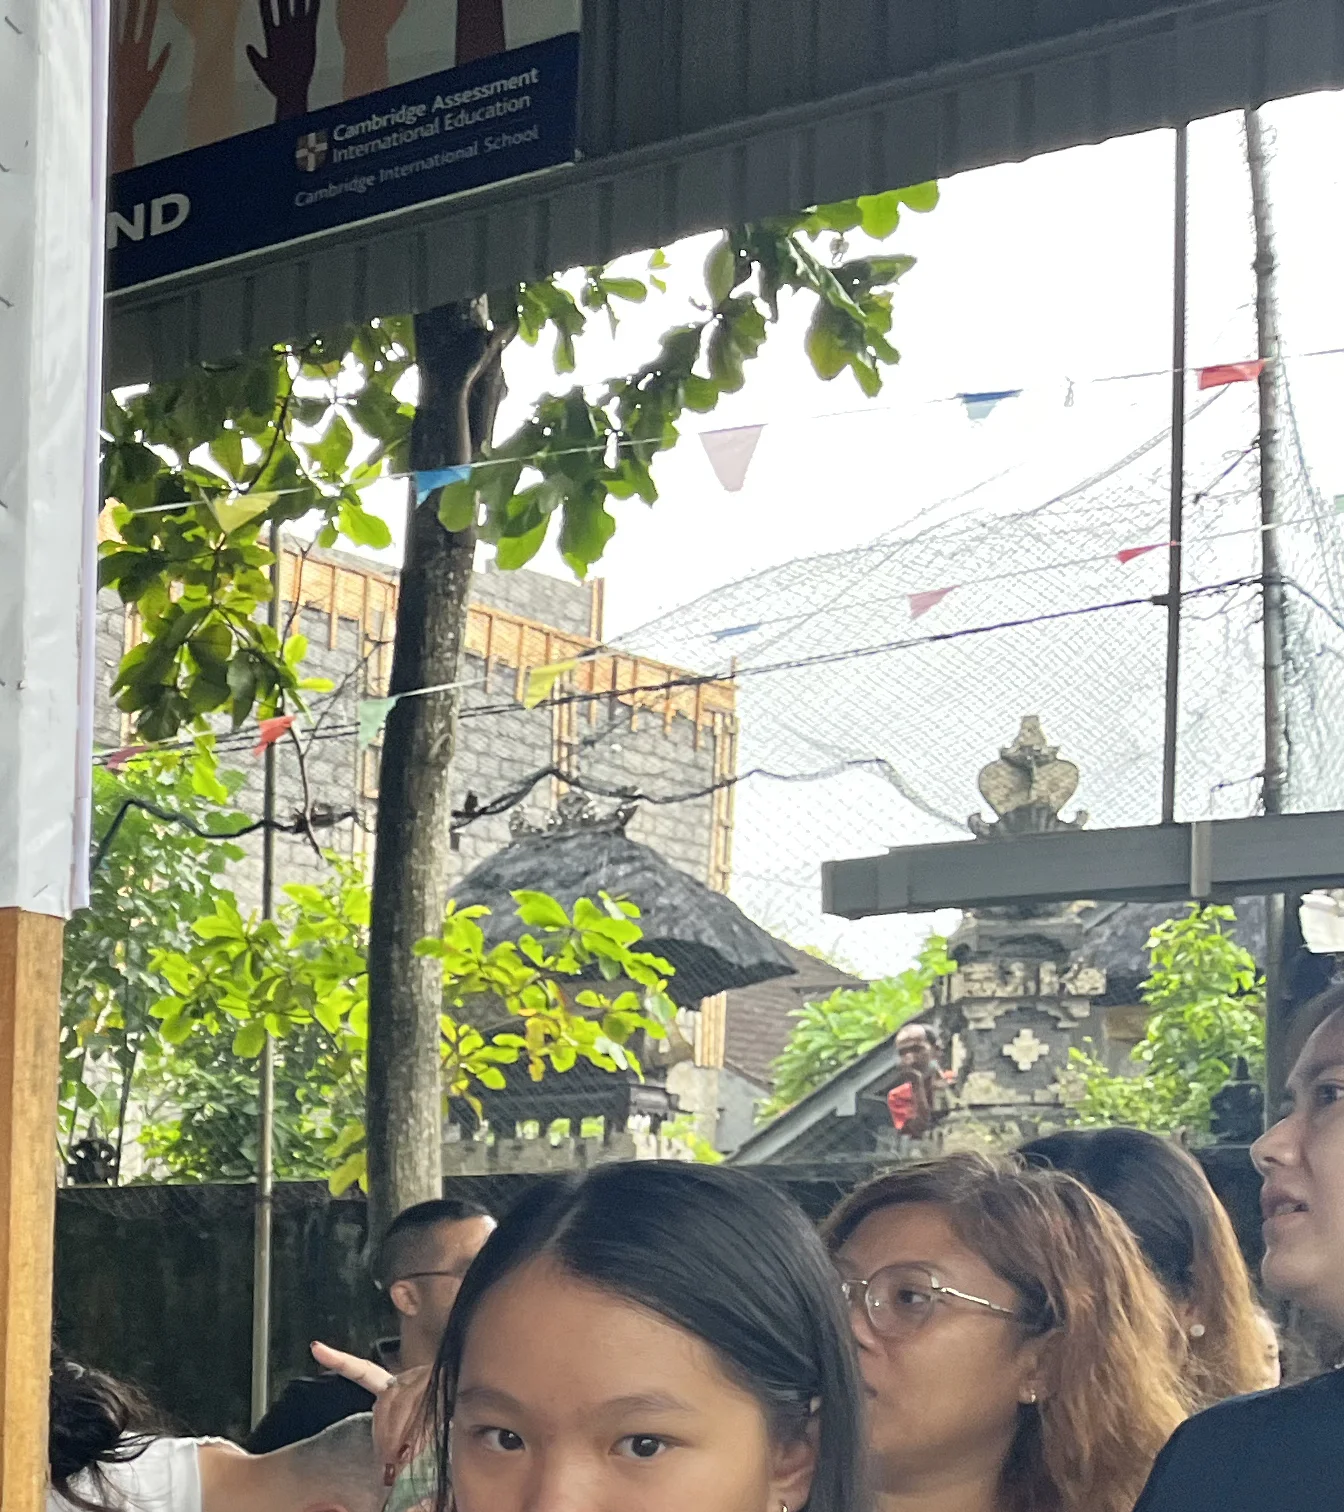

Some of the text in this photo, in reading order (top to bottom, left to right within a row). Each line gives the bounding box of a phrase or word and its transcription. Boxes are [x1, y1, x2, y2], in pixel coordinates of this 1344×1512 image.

[333, 67, 540, 141] Cambridge Assessment
[333, 94, 531, 162] International Education
[294, 124, 540, 208] Cambridge International School
